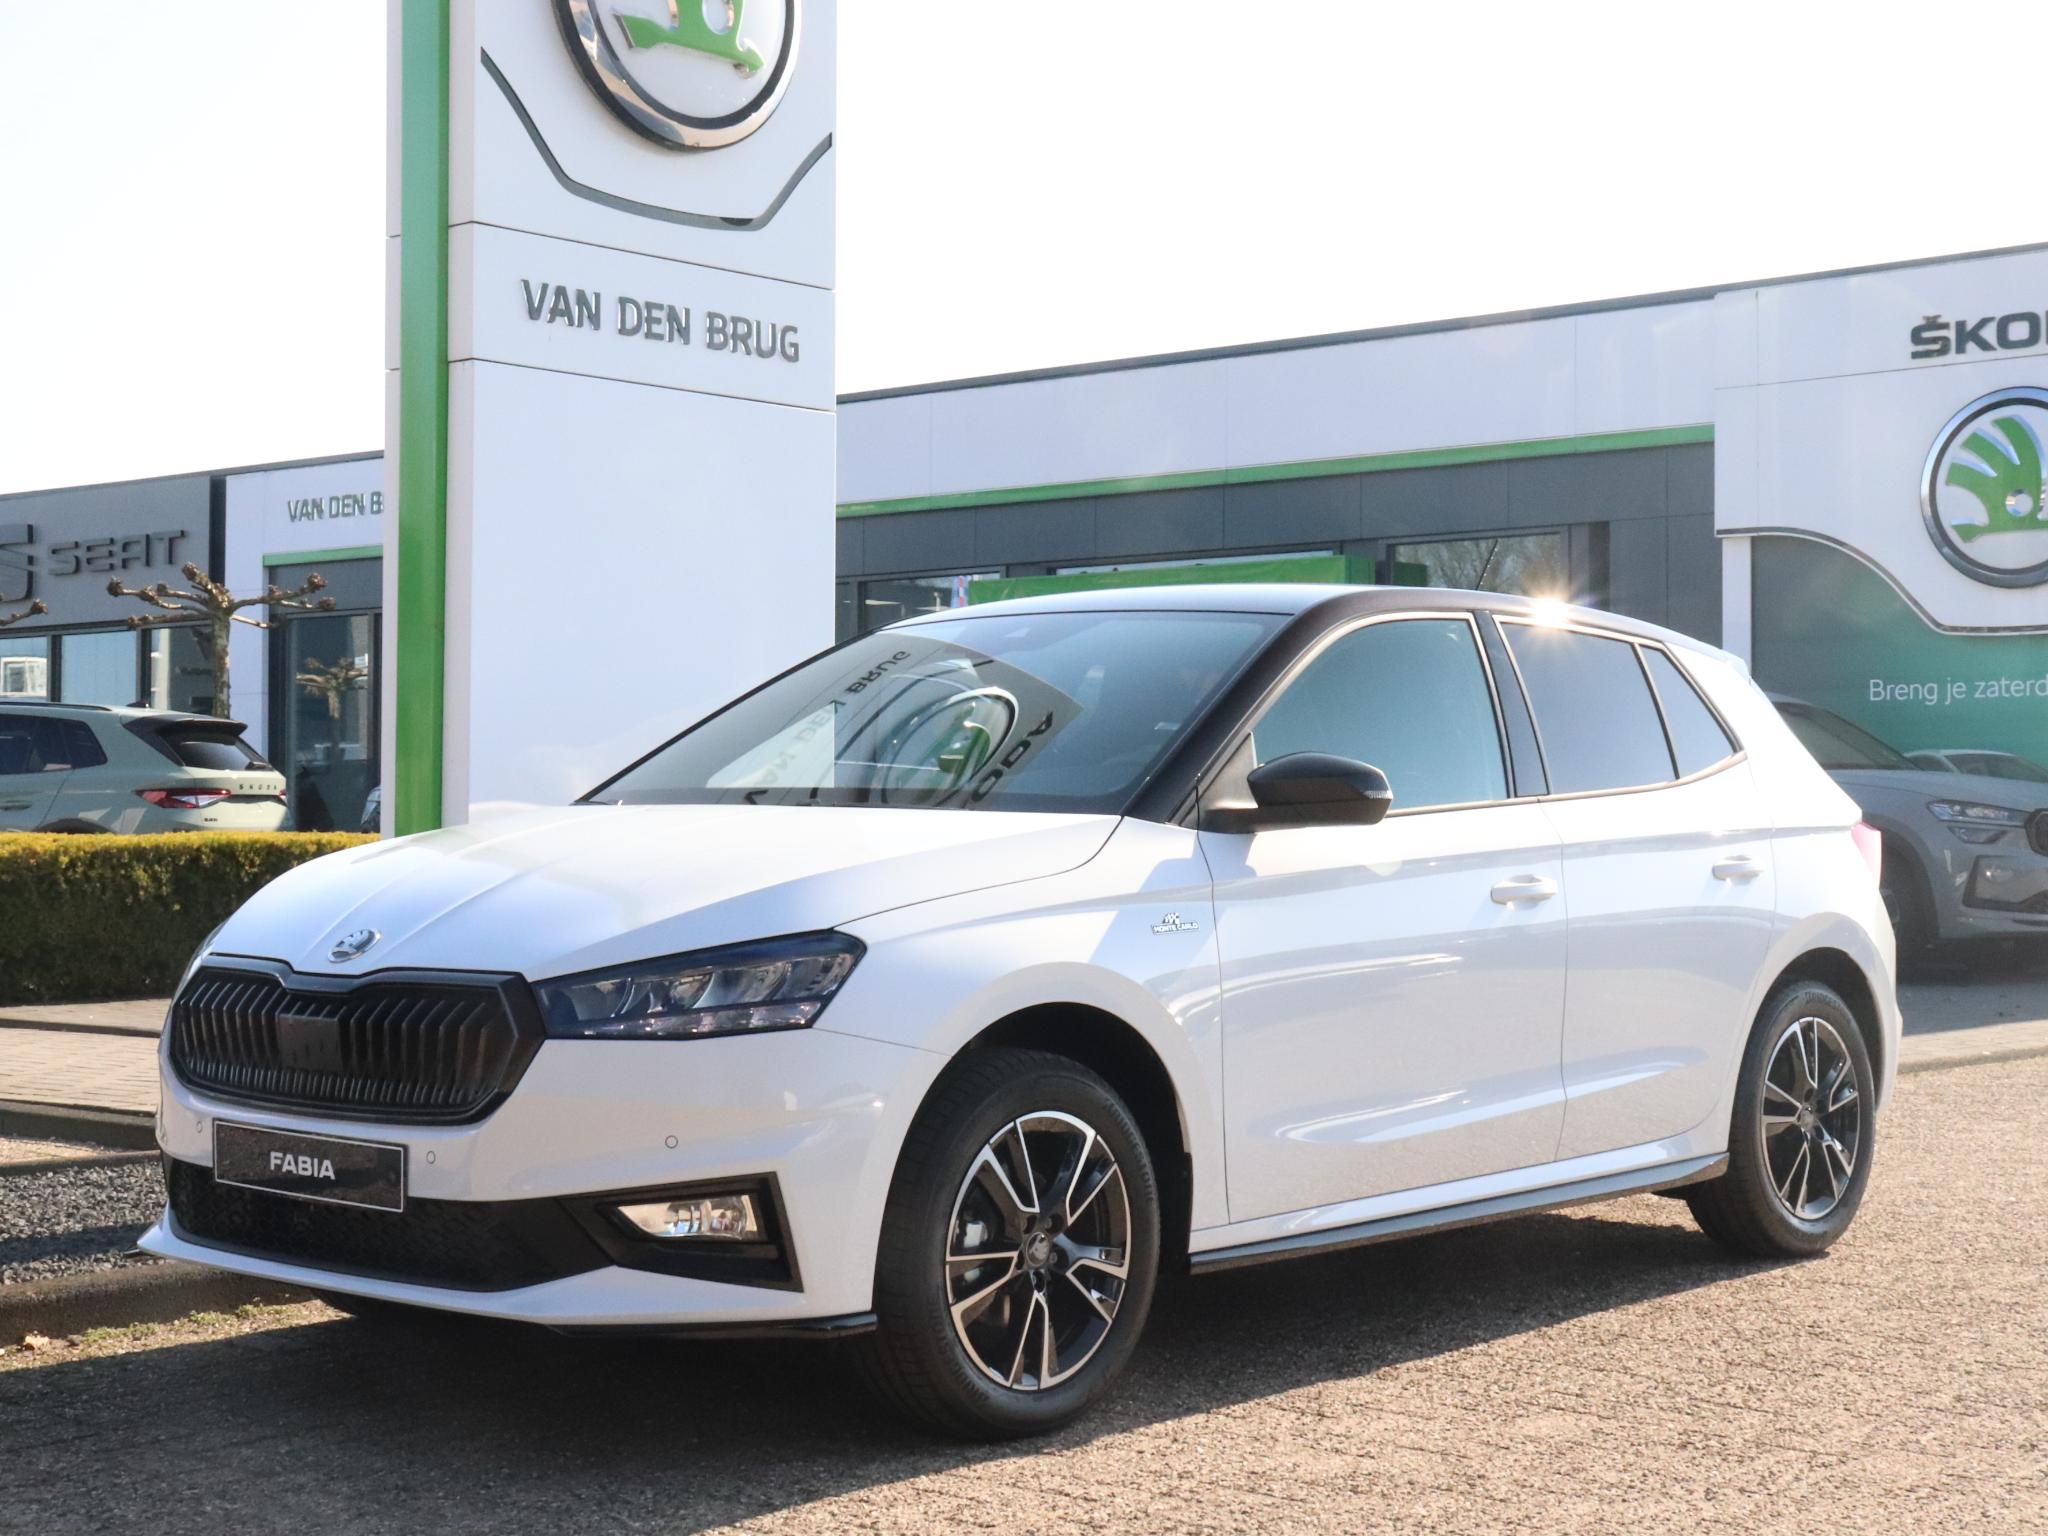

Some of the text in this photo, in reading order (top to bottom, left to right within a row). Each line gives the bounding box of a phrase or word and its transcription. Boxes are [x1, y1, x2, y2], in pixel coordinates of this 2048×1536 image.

[520, 279, 799, 363] VAN DEN BRUG
[1910, 309, 2048, 360] ŠKO
[287, 497, 324, 522] VAN
[328, 493, 365, 519] DEN
[48, 530, 187, 577] SEAT
[1869, 679, 1938, 706] Breng
[1944, 677, 1967, 705] je
[269, 1151, 336, 1181] FABIA
